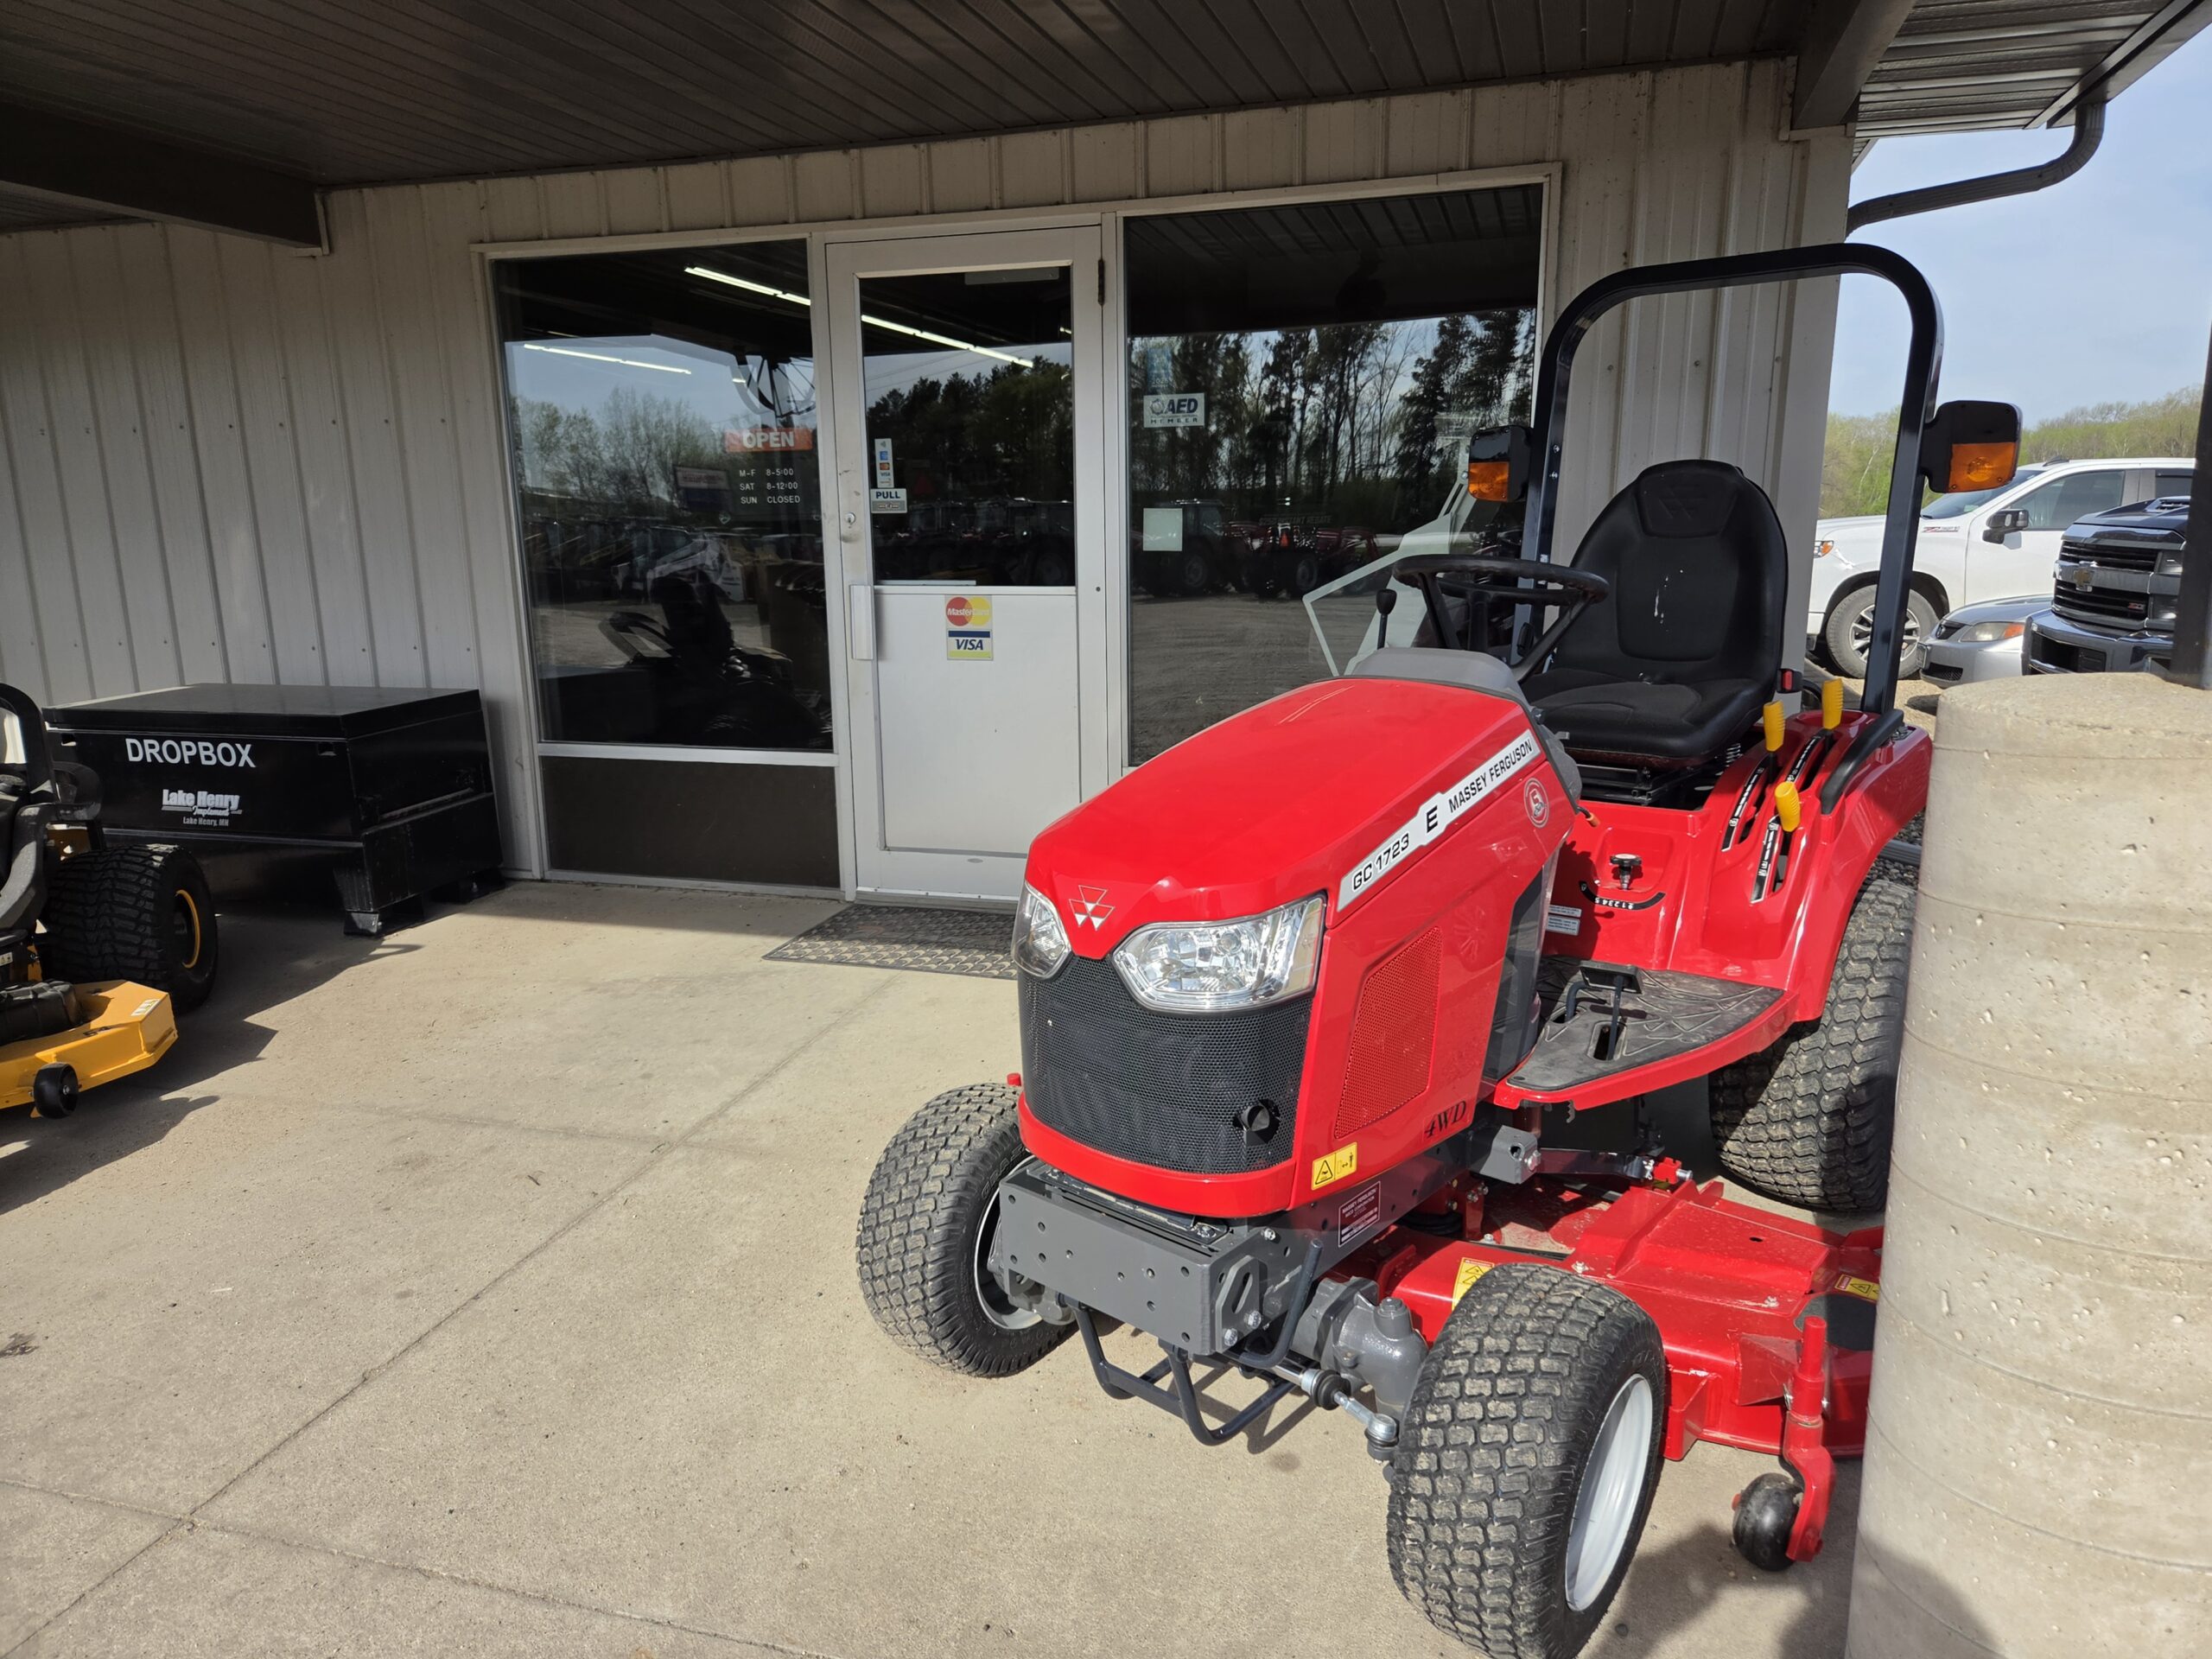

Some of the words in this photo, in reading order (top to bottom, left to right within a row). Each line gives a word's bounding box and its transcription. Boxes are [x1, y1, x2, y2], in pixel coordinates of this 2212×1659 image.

[1166, 397, 1198, 414] AED
[743, 430, 795, 448] OPEN
[955, 639, 984, 651] VISA
[125, 738, 257, 768] DROPBOX
[162, 789, 195, 806] Lake
[197, 791, 240, 810] Henry
[1352, 863, 1373, 891] GC
[1375, 833, 1409, 870] 1723
[1448, 772, 1487, 813] MASSEY
[1489, 739, 1533, 782] FERGUSON
[1424, 1100, 1466, 1138] 4WD
